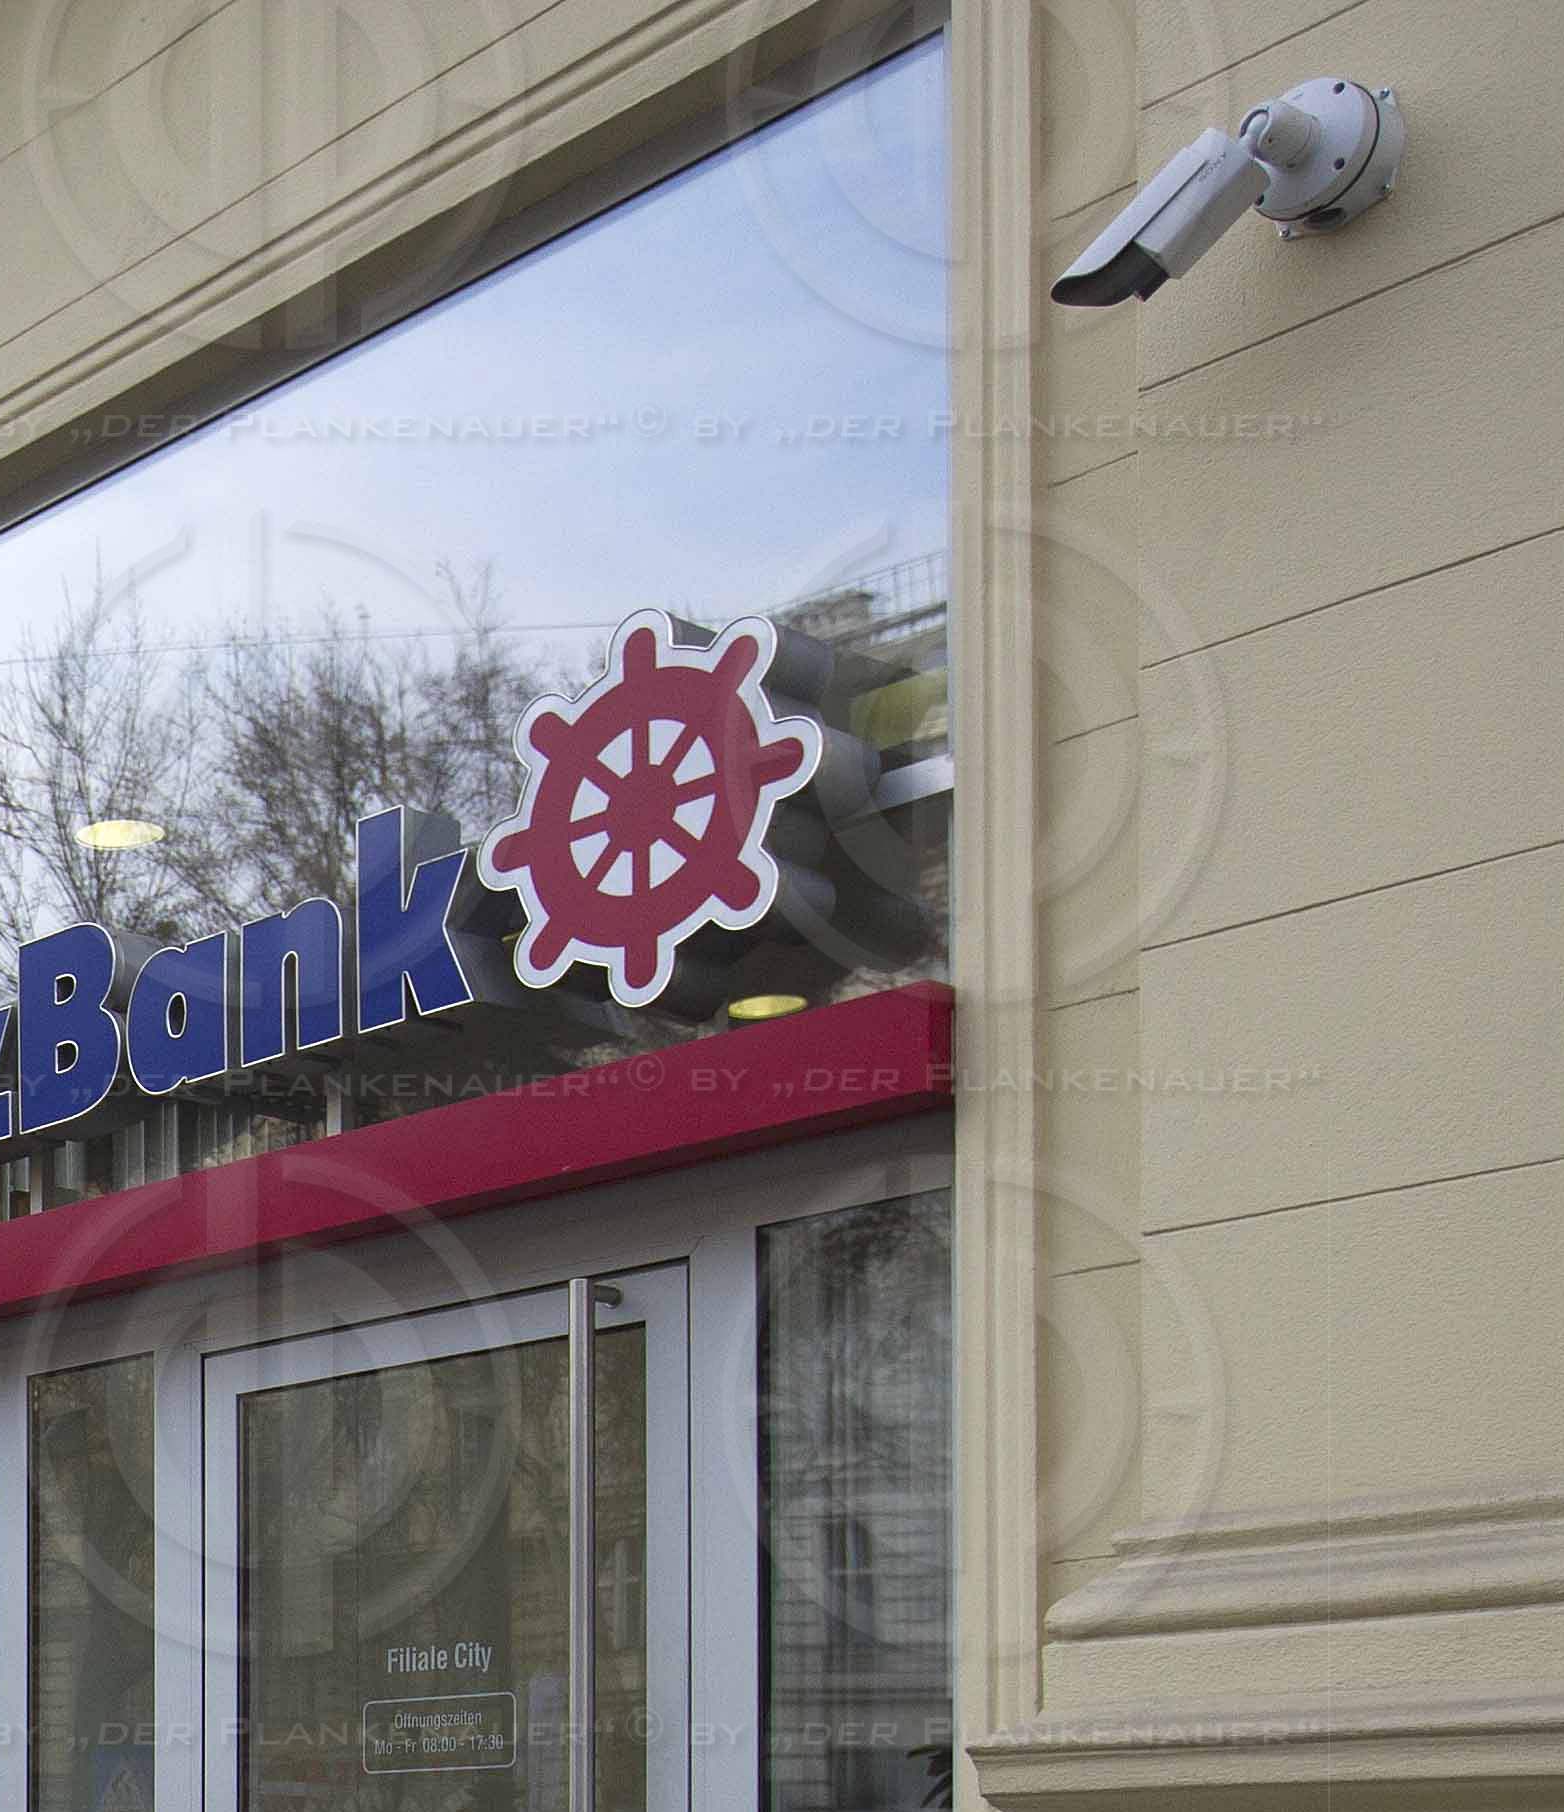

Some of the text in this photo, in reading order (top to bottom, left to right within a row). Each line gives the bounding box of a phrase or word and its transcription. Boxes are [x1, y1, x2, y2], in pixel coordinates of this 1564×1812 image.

[386, 1642, 492, 1673] Filiale City
[375, 1739, 393, 1756] Mo
[422, 1737, 456, 1753] 08:00
